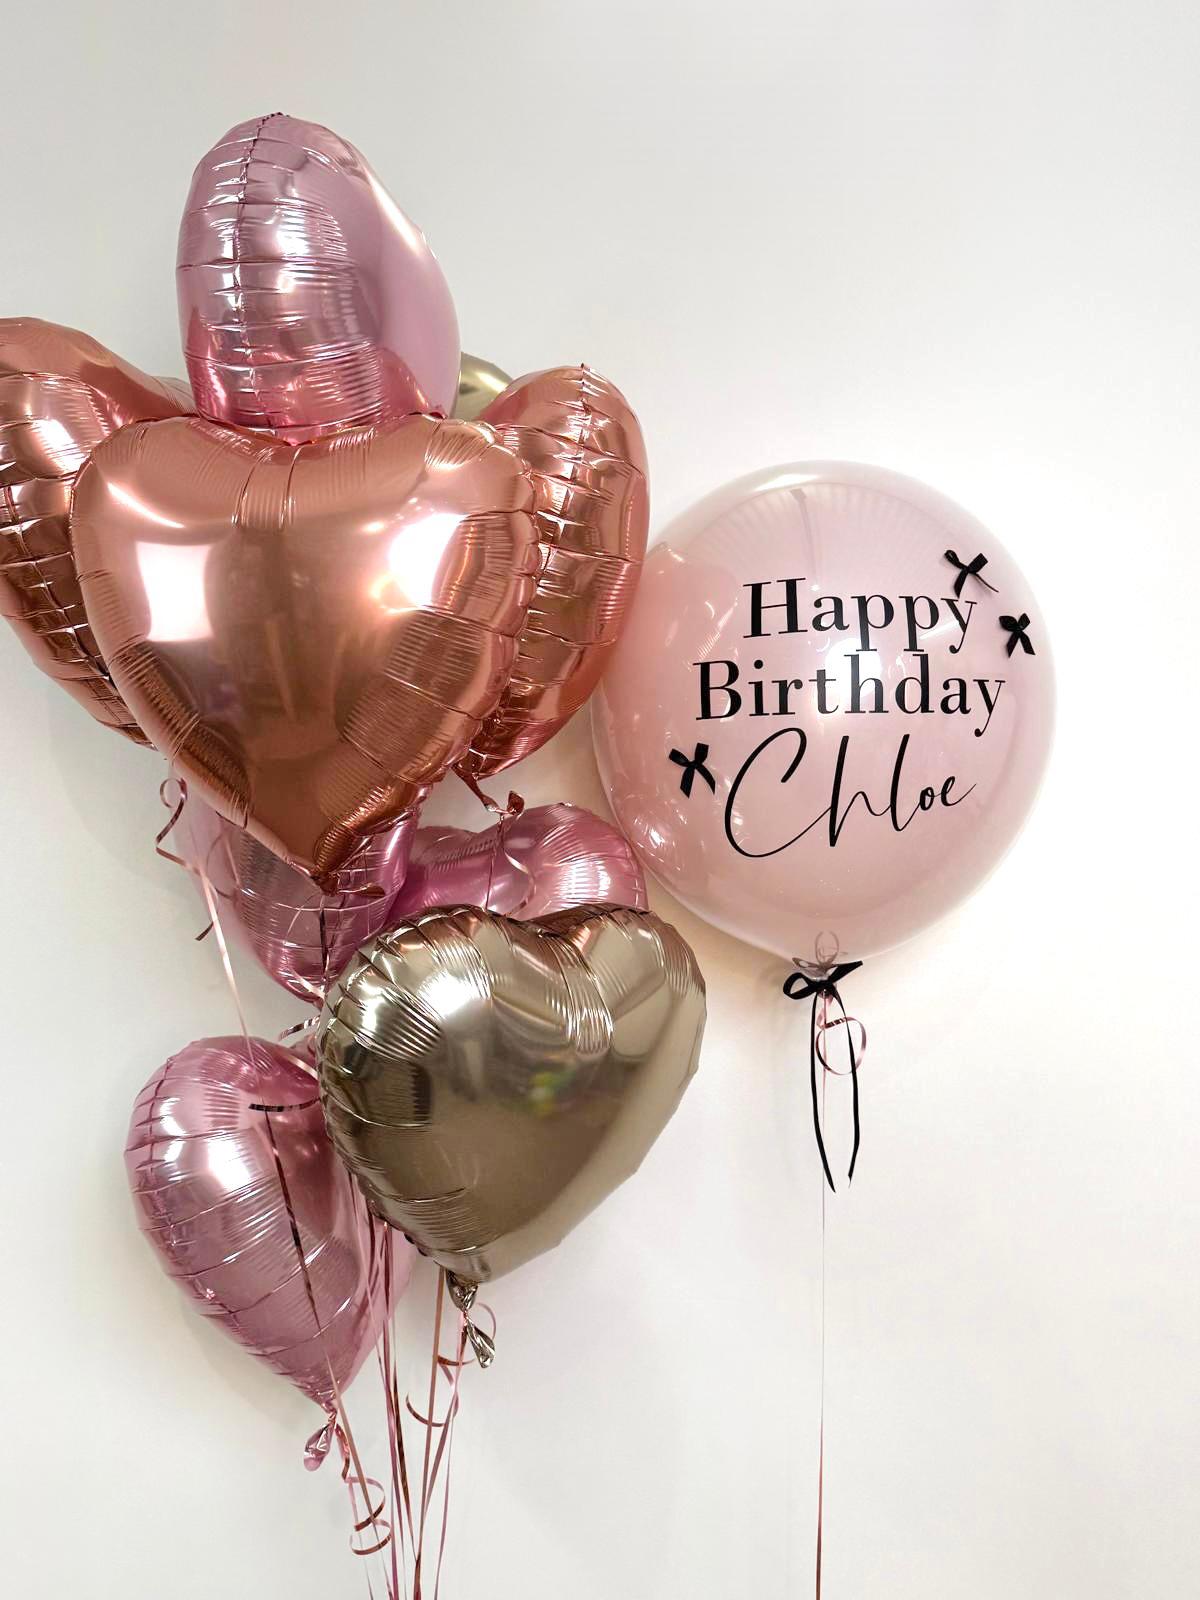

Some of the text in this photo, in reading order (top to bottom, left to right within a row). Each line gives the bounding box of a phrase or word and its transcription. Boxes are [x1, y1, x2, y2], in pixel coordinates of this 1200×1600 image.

[743, 577, 977, 654] Happy
[693, 653, 1006, 738] Birthday
[724, 727, 977, 858] Chloe
